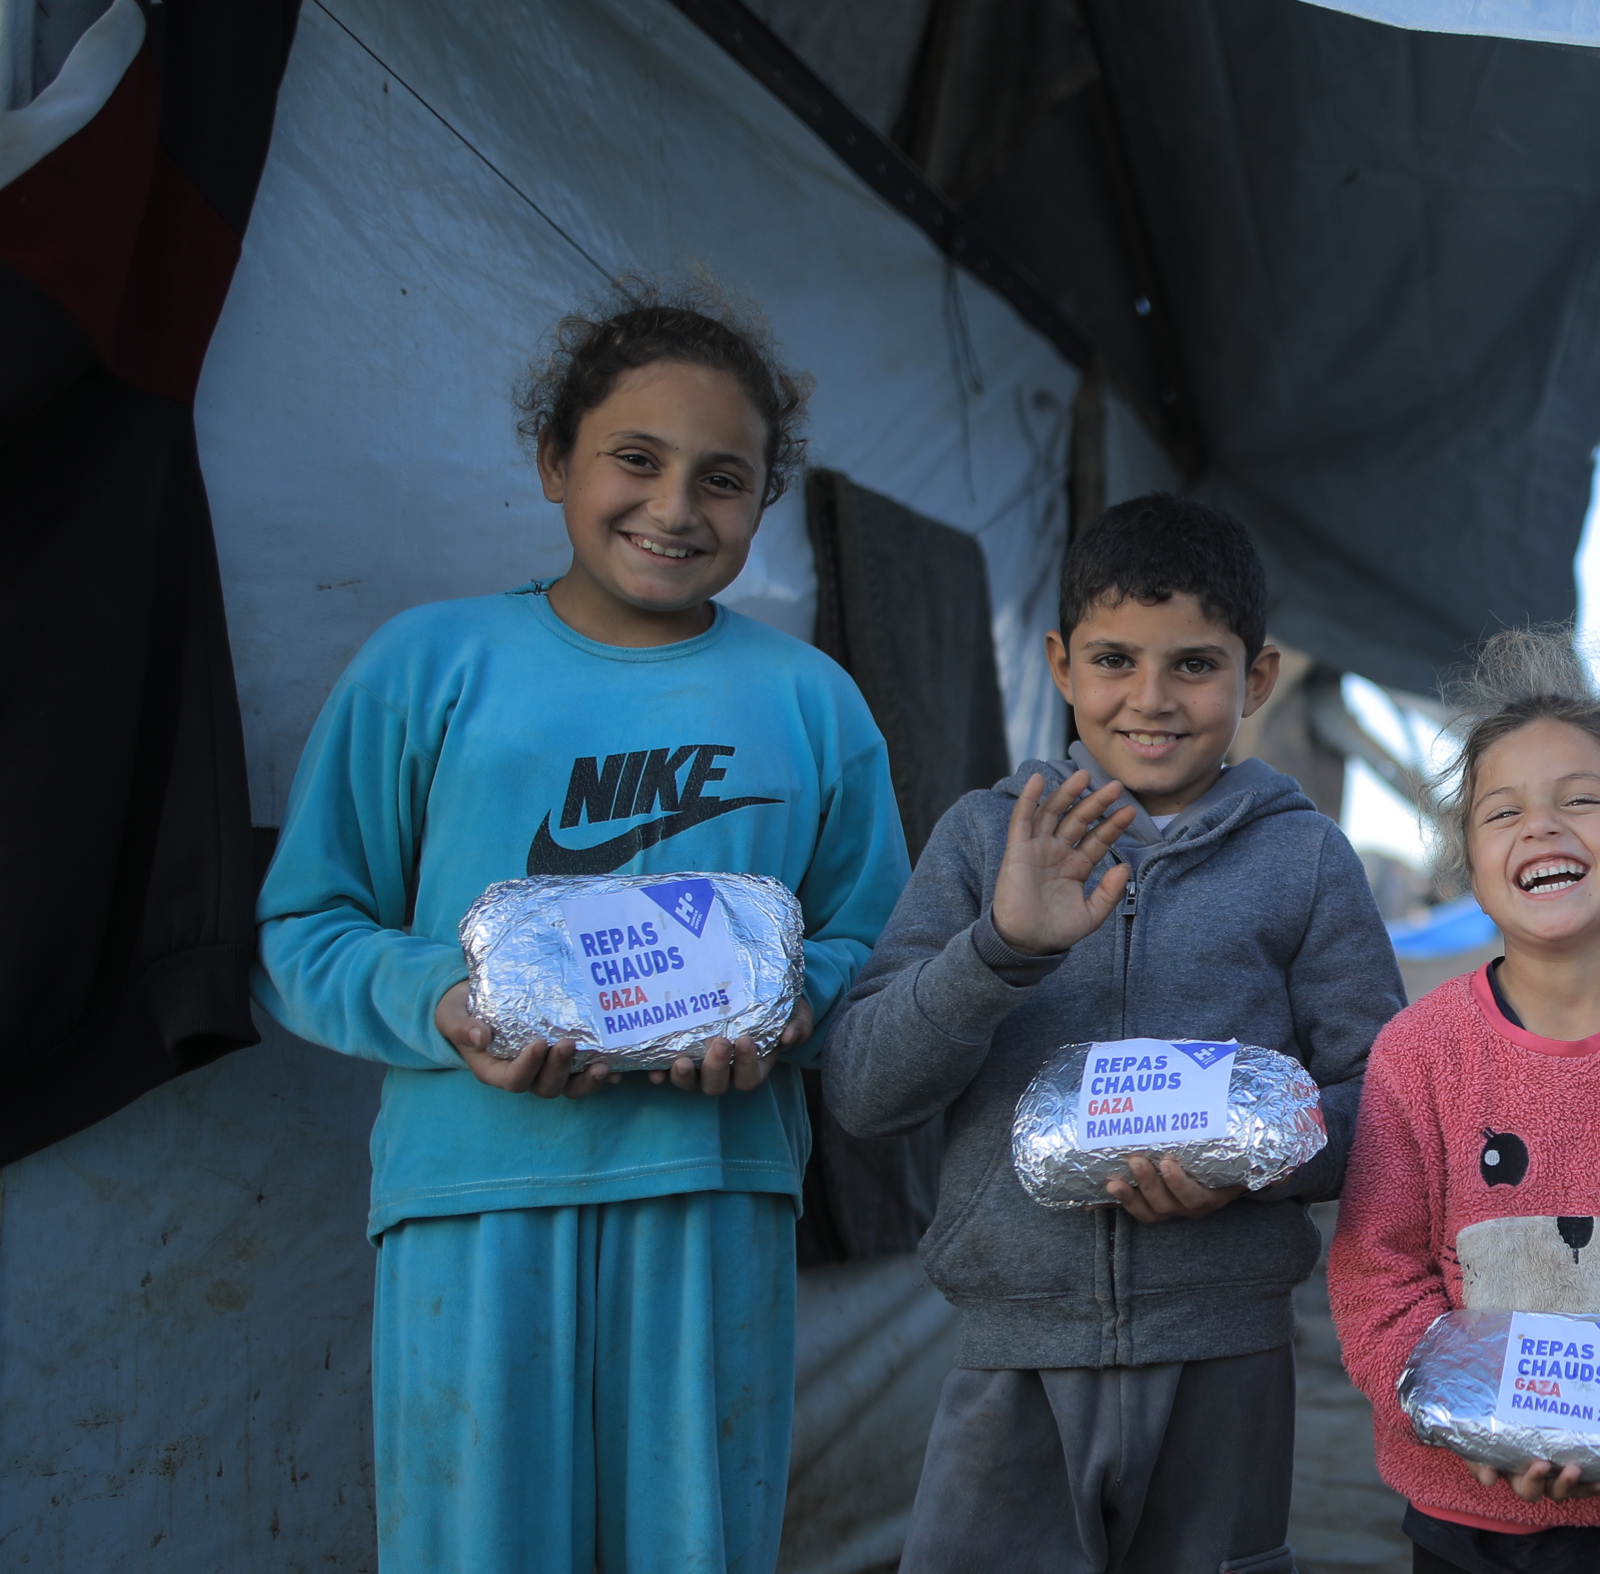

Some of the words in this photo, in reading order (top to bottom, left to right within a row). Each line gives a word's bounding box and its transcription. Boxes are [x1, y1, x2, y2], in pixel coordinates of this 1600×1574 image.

[559, 744, 736, 830] NIKE
[579, 921, 659, 958] REPAS
[590, 946, 685, 987] CHAUDS
[599, 985, 648, 1012] GAZA
[604, 995, 689, 1035] RAMADAN
[690, 989, 730, 1015] 2025
[1094, 1055, 1168, 1074] REPAS
[1091, 1072, 1182, 1095] CHAUDS
[1088, 1097, 1134, 1116] GAZA
[1086, 1114, 1167, 1139] RAMADAN
[1171, 1111, 1209, 1131] 2025
[1520, 1338, 1595, 1360] REPAS
[1514, 1377, 1561, 1398] GAZA
[1511, 1393, 1594, 1420] RAMADAN
